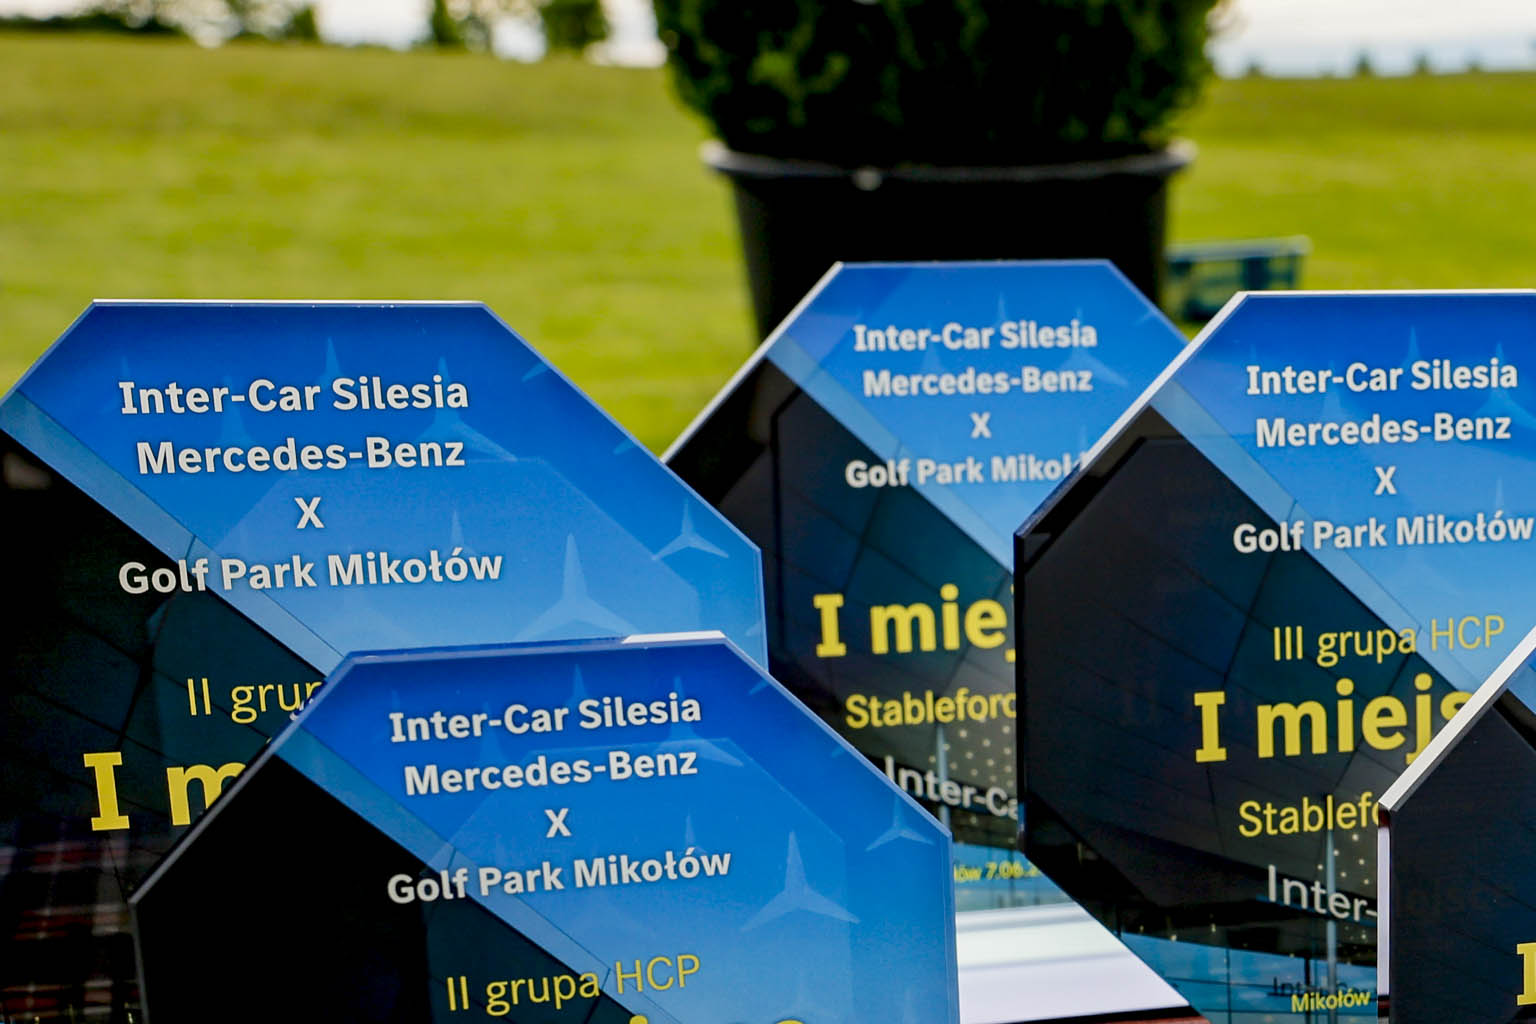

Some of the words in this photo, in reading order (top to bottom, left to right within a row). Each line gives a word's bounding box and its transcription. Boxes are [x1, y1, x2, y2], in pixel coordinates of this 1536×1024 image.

[853, 322, 994, 352] Inter-Car
[1000, 319, 1097, 349] Silesia
[119, 378, 320, 414] Inter-Car
[332, 374, 469, 410] Silesia
[863, 366, 1093, 397] Mercedes-Benz
[1246, 362, 1403, 395] Inter-Car
[1411, 358, 1518, 390] Silesia
[1256, 412, 1511, 447] Mercedes-Benz
[136, 436, 465, 474] Mercedes-Benz
[845, 457, 910, 488] Golf
[917, 456, 982, 485] Park
[991, 451, 1087, 482] Mikoł
[1233, 520, 1304, 553] Golf
[1313, 517, 1387, 550] Park
[1396, 510, 1535, 545] Mikołów
[118, 558, 209, 594] Golf
[221, 555, 316, 591] Park
[328, 547, 503, 587] Mikołów
[813, 593, 846, 658] I
[1273, 625, 1303, 661] III
[1316, 627, 1417, 668] grupa
[1431, 615, 1505, 651] HCP
[187, 677, 212, 716] II
[389, 704, 569, 742] Inter-Car
[578, 692, 701, 729] Silesia
[1194, 690, 1227, 763] I
[1257, 672, 1474, 766] miej
[83, 752, 130, 831] I
[404, 750, 698, 796] Mercedes-Benz
[1239, 791, 1379, 837] Stablef
[387, 867, 468, 904] Golf
[478, 861, 565, 896] Park
[573, 847, 731, 888] Mikołów
[446, 976, 469, 1011] II
[486, 971, 600, 1016] grupa
[615, 954, 700, 994] HCP
[1291, 988, 1371, 1013] Mikołów
